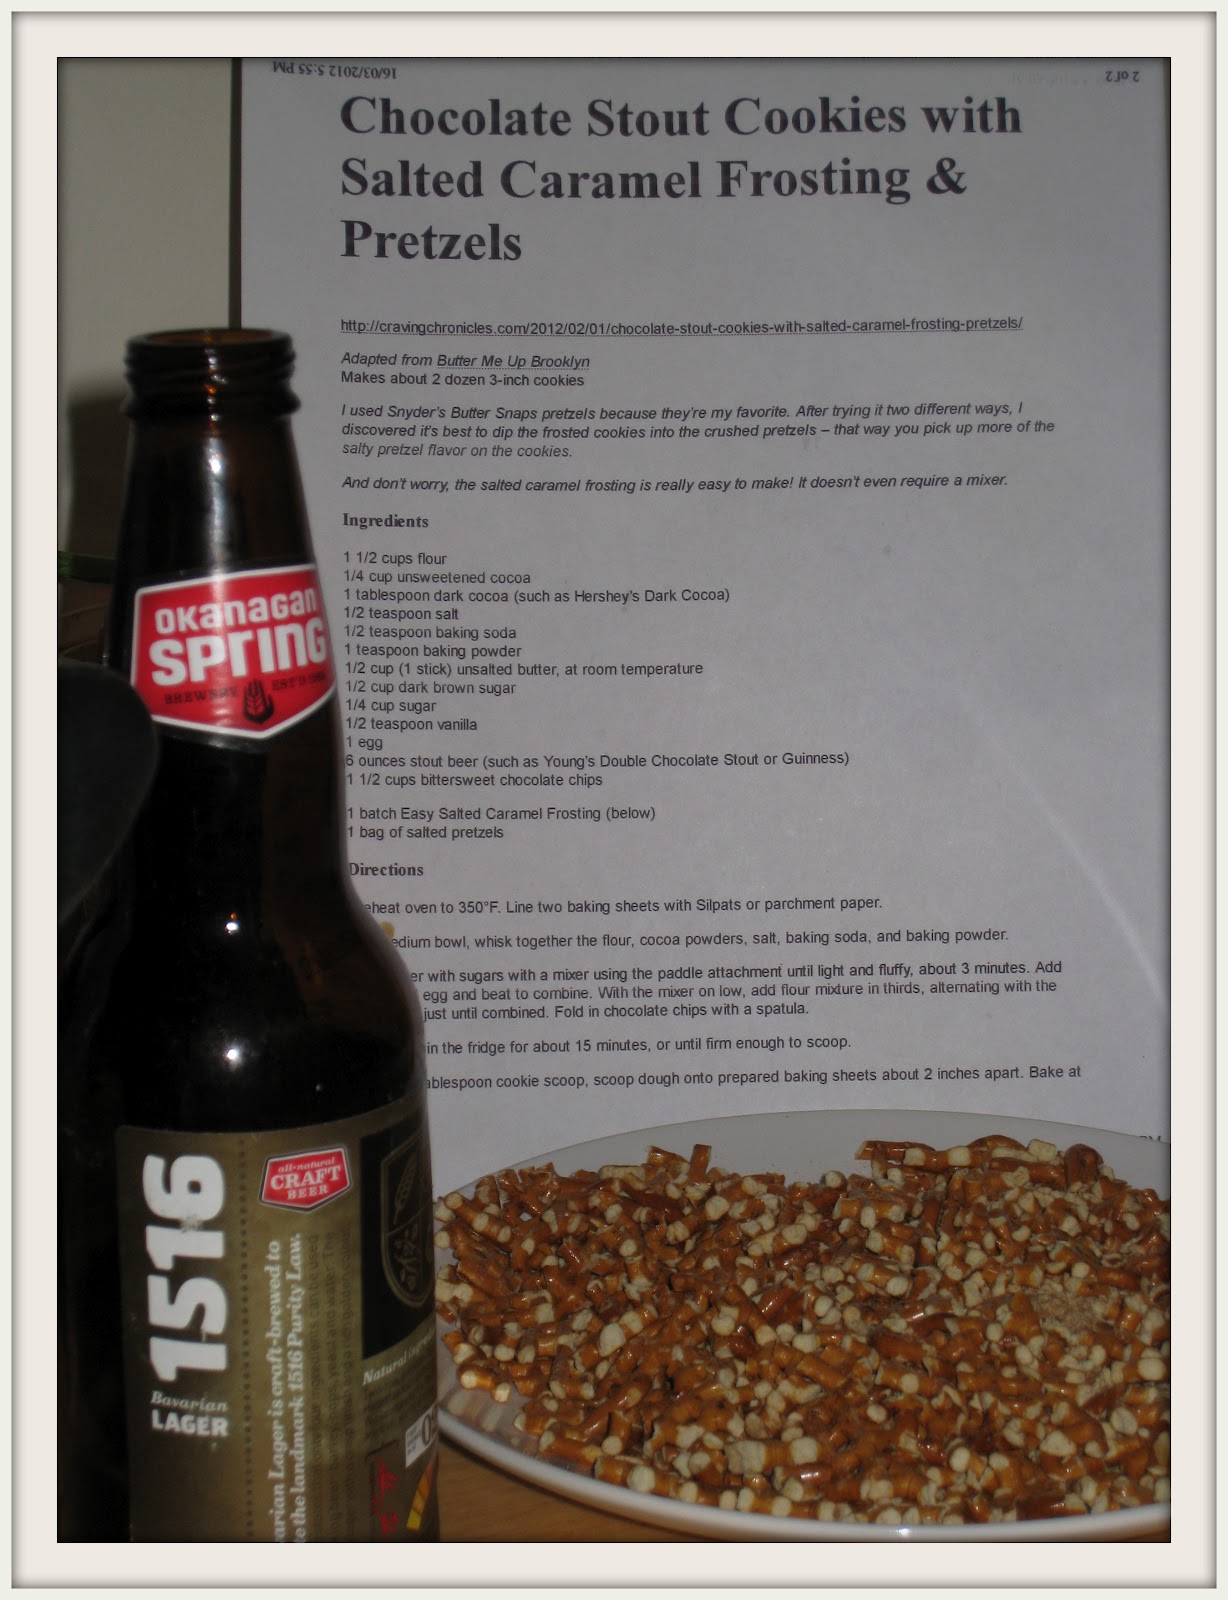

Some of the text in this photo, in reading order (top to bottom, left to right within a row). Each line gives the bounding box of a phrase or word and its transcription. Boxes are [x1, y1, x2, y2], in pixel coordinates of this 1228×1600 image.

[272, 61, 397, 79] 16/03/2012 5:55 PM
[1104, 70, 1113, 83] 2
[1113, 71, 1130, 83] of
[1132, 70, 1141, 83] 2
[340, 95, 1023, 138] Chocolate Stout Cookies with
[341, 156, 968, 206] Salted Caramel Frosting &
[340, 219, 522, 261] Pretzels
[340, 351, 591, 371] Adapted from Butter Me Up Brooklyn
[340, 370, 585, 387] Makes about 2 dozen 3-inch cookies
[342, 512, 430, 531] Ingredients
[343, 550, 448, 568] 1 1/2 cups flour
[343, 568, 532, 586] 1/4 cup unsweetened cocoa
[343, 587, 350, 601] 1
[354, 587, 431, 605] tablespoon
[433, 589, 465, 603] dark
[468, 591, 509, 603] cocoa
[513, 589, 551, 606] (such
[553, 592, 571, 603] as
[644, 588, 678, 603] Dark
[681, 587, 731, 604] Cocoa)
[344, 642, 523, 661] 1 teaspoon baking powder
[345, 661, 704, 679] 1/2 cup (1 stick) unsalted butter, at room temperature
[345, 698, 437, 715] 1/4 cup sugar
[346, 753, 354, 767] 6
[358, 756, 407, 768] ounces
[409, 755, 444, 768] stout
[447, 754, 479, 768] beer
[482, 755, 520, 771] (such
[522, 757, 540, 768] as
[599, 754, 648, 768] Double
[650, 753, 720, 767] Chocolate
[723, 753, 760, 766] Stout
[763, 754, 779, 766] or
[781, 751, 850, 767] Guinness)
[347, 772, 604, 789] 1 1/2 cups bittersweet chocolate chips
[347, 806, 656, 823] 1 batch Easy Salted Caramel Frosting (below)
[348, 825, 505, 842] 1 bag of salted pretzels
[349, 862, 425, 877] Directions
[404, 896, 883, 916] oven to 350°F. Line two baking sheets with Silpats or parchment paper.
[423, 1001, 809, 1023] just until combined. Fold in chocolate chips with a spatula.
[427, 1035, 852, 1057] in the fridge for about 15 minutes, or until firm enough to scoop.
[270, 1165, 342, 1191] CRAFT
[286, 1184, 329, 1200] BEER
[265, 1241, 281, 1260] to
[285, 1233, 302, 1281] Law.
[143, 1154, 228, 1382] 1516
[286, 1284, 305, 1349] Purity
[264, 1265, 283, 1397] craft-brewed
[287, 1351, 304, 1393] 1516
[362, 1350, 407, 1386] Natural
[151, 1389, 228, 1413] Bavarian
[267, 1400, 284, 1418] is
[151, 1407, 229, 1437] LAGER
[267, 1419, 288, 1482] Lager
[288, 1398, 305, 1494] landmark
[290, 1496, 306, 1526] the
